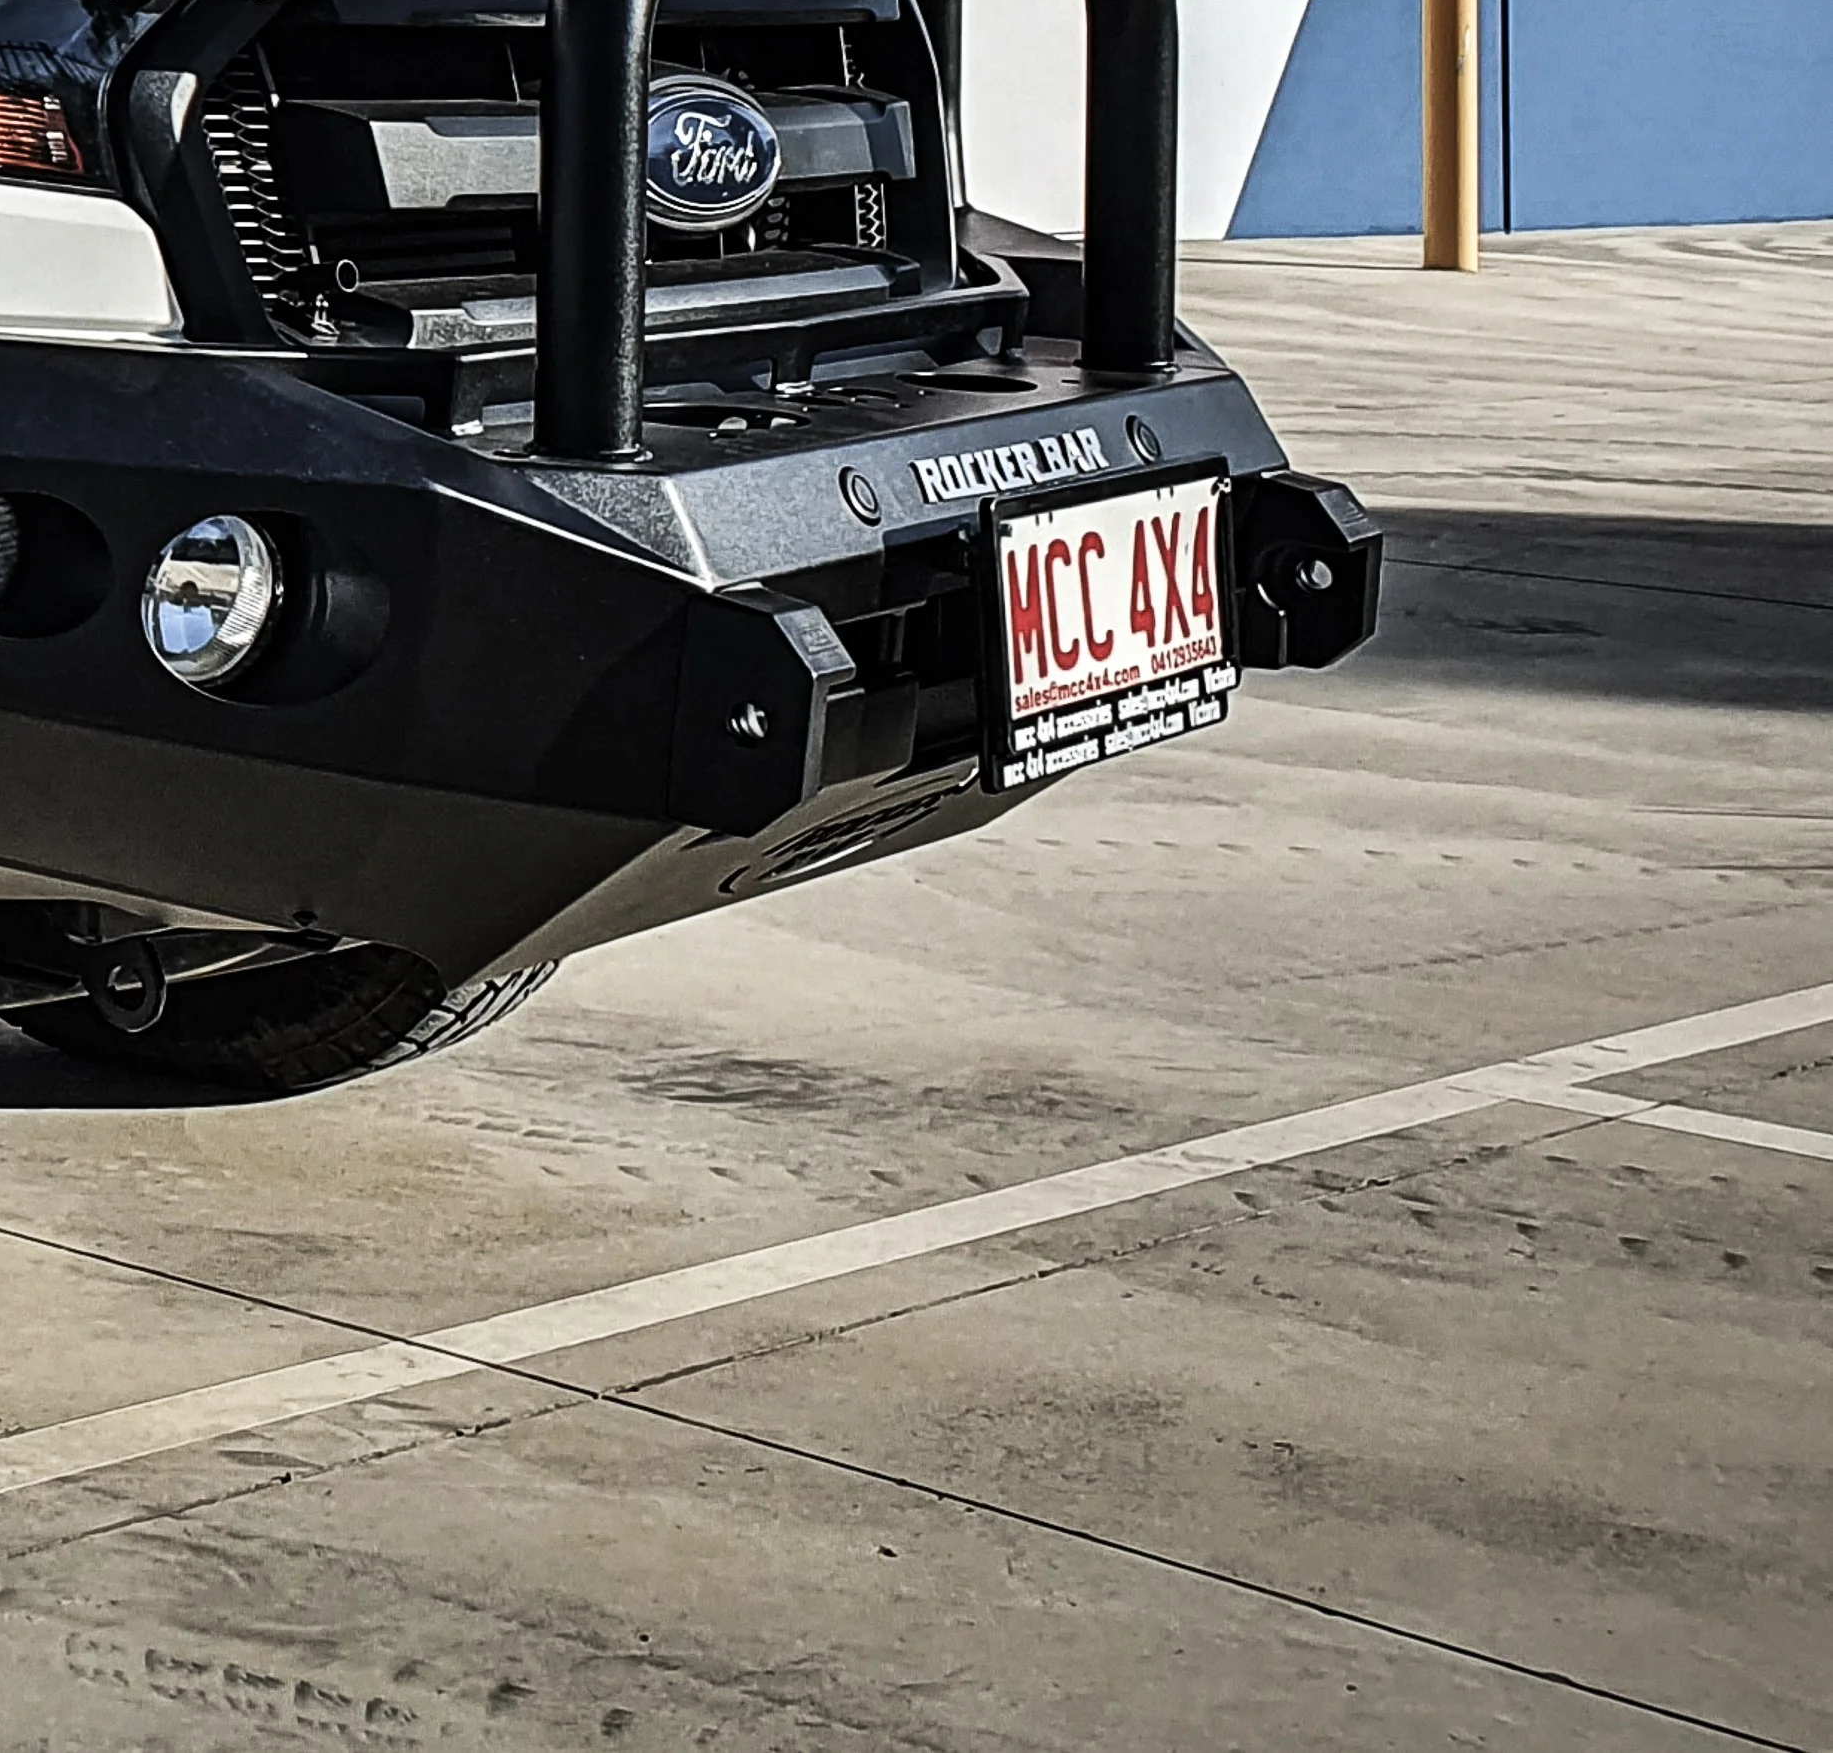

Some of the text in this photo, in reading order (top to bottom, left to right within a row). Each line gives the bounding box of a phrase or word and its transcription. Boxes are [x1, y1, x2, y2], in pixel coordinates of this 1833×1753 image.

[670, 111, 758, 187] Ford
[911, 427, 1111, 504] ROCKER BAR
[1007, 506, 1215, 684] MCC 4X4
[1014, 665, 1140, 713] sales@mcc4x4.com
